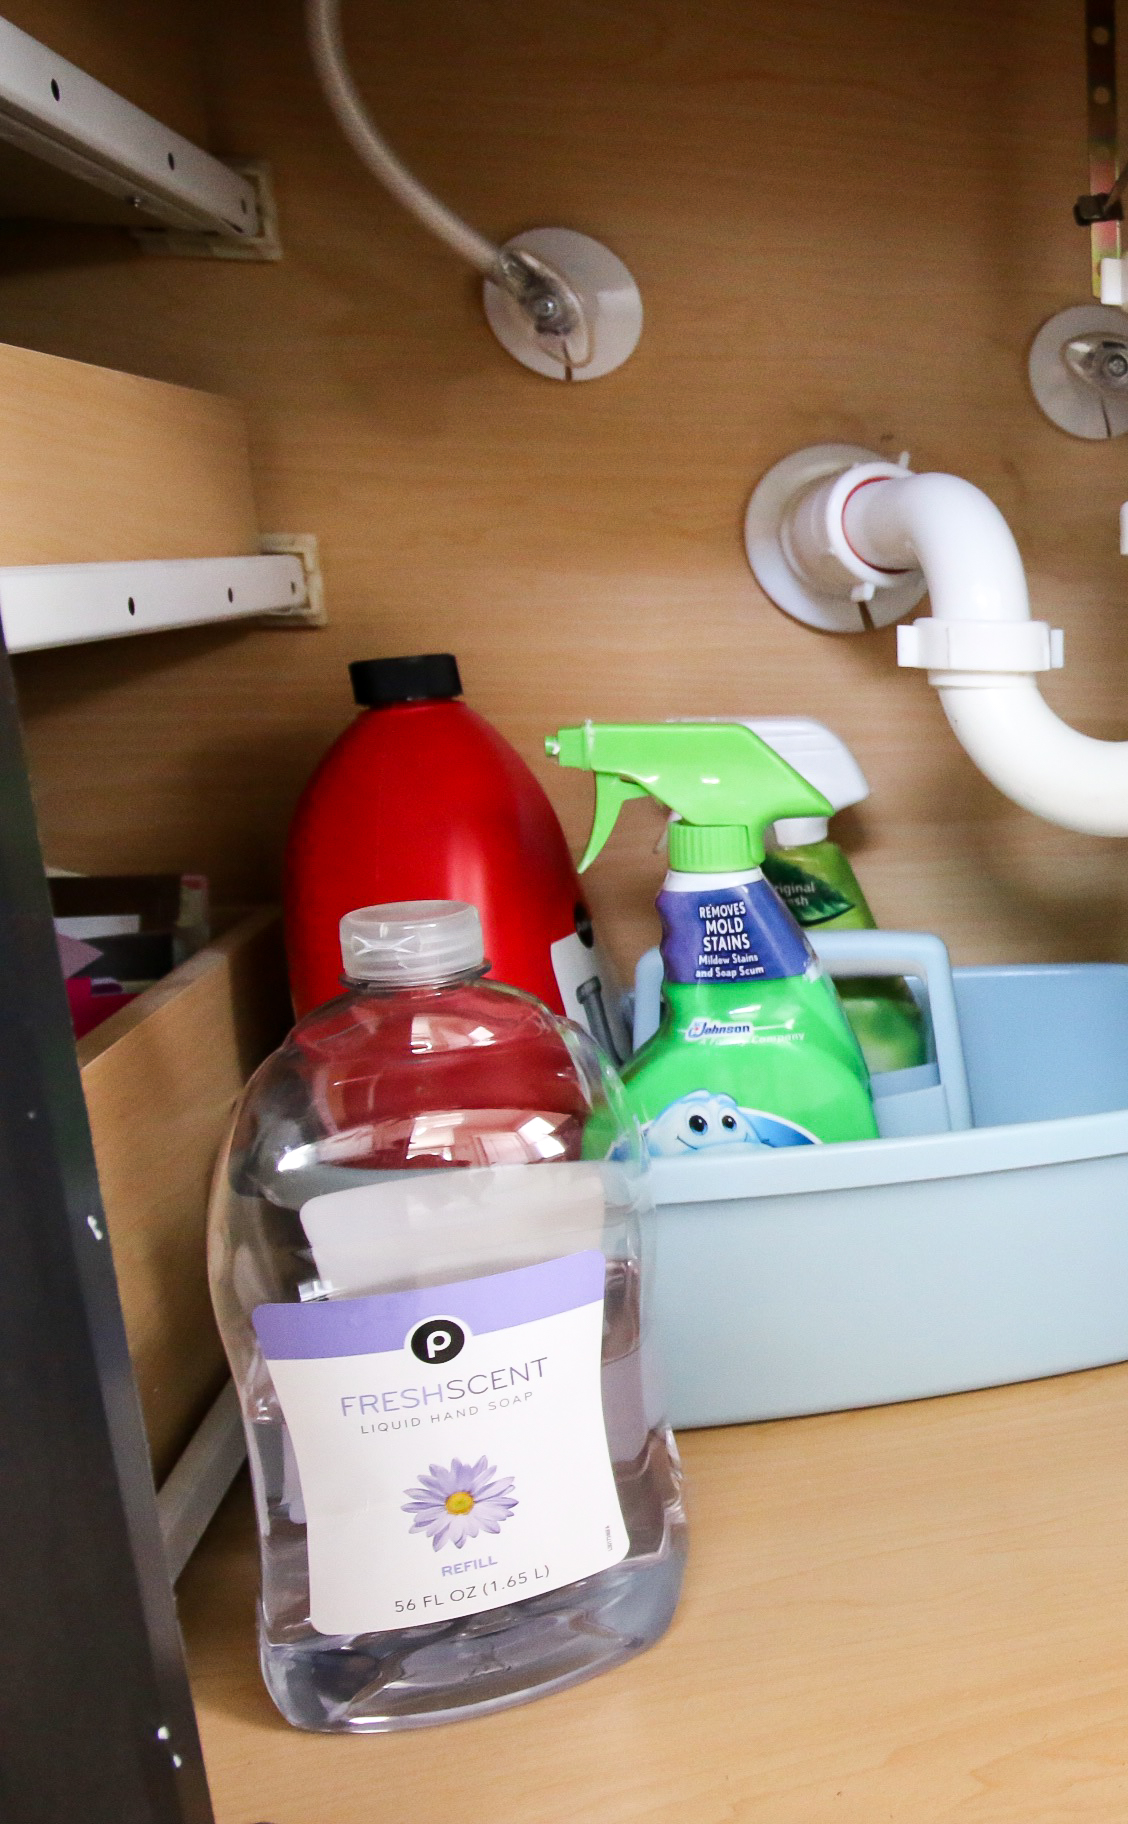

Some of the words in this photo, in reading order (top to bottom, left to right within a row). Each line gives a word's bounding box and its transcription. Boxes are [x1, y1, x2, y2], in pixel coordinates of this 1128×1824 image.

[774, 881, 816, 897] riginal
[698, 901, 747, 919] REMOVES
[705, 916, 744, 936] MOLD
[702, 932, 751, 952] STAINS
[698, 954, 730, 966] Mildew
[731, 952, 759, 964] Stains
[695, 967, 713, 978] and
[714, 966, 737, 979] Soap
[738, 965, 765, 976] Scum
[687, 1021, 751, 1039] Johnson
[340, 1356, 549, 1417] FRESHSCENT
[360, 1416, 421, 1435] LIQUID
[430, 1405, 480, 1424] HAND
[488, 1391, 534, 1411] SOAP
[441, 1555, 499, 1577] REFILL
[394, 1598, 417, 1613] 56
[423, 1594, 445, 1608] FL
[449, 1585, 478, 1602] OZ
[482, 1571, 528, 1597] (1.65
[534, 1564, 551, 1579] L)
